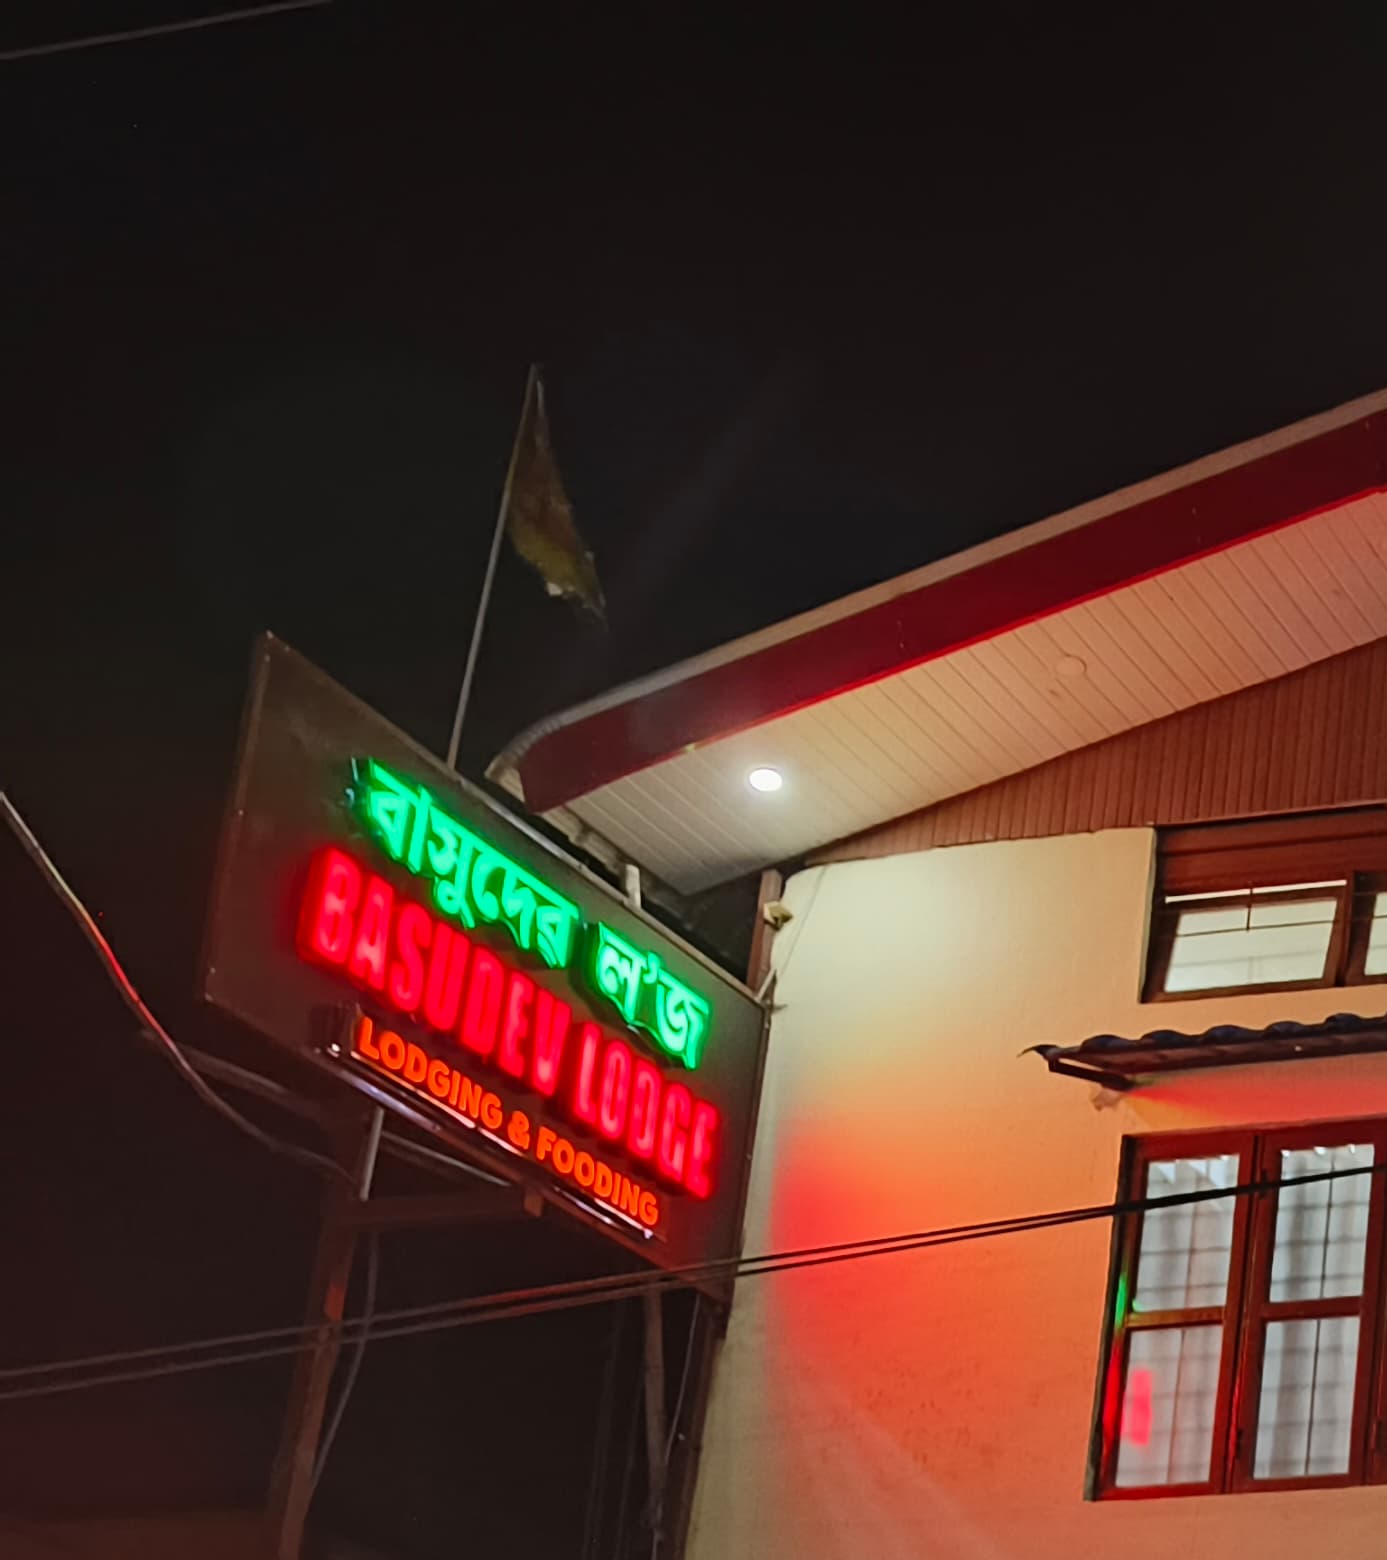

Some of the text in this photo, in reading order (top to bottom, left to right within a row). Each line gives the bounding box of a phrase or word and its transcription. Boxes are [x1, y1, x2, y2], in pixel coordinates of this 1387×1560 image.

[309, 848, 721, 1200] BASUDEV LODGE
[358, 1017, 660, 1226] LODGING & FOODING
